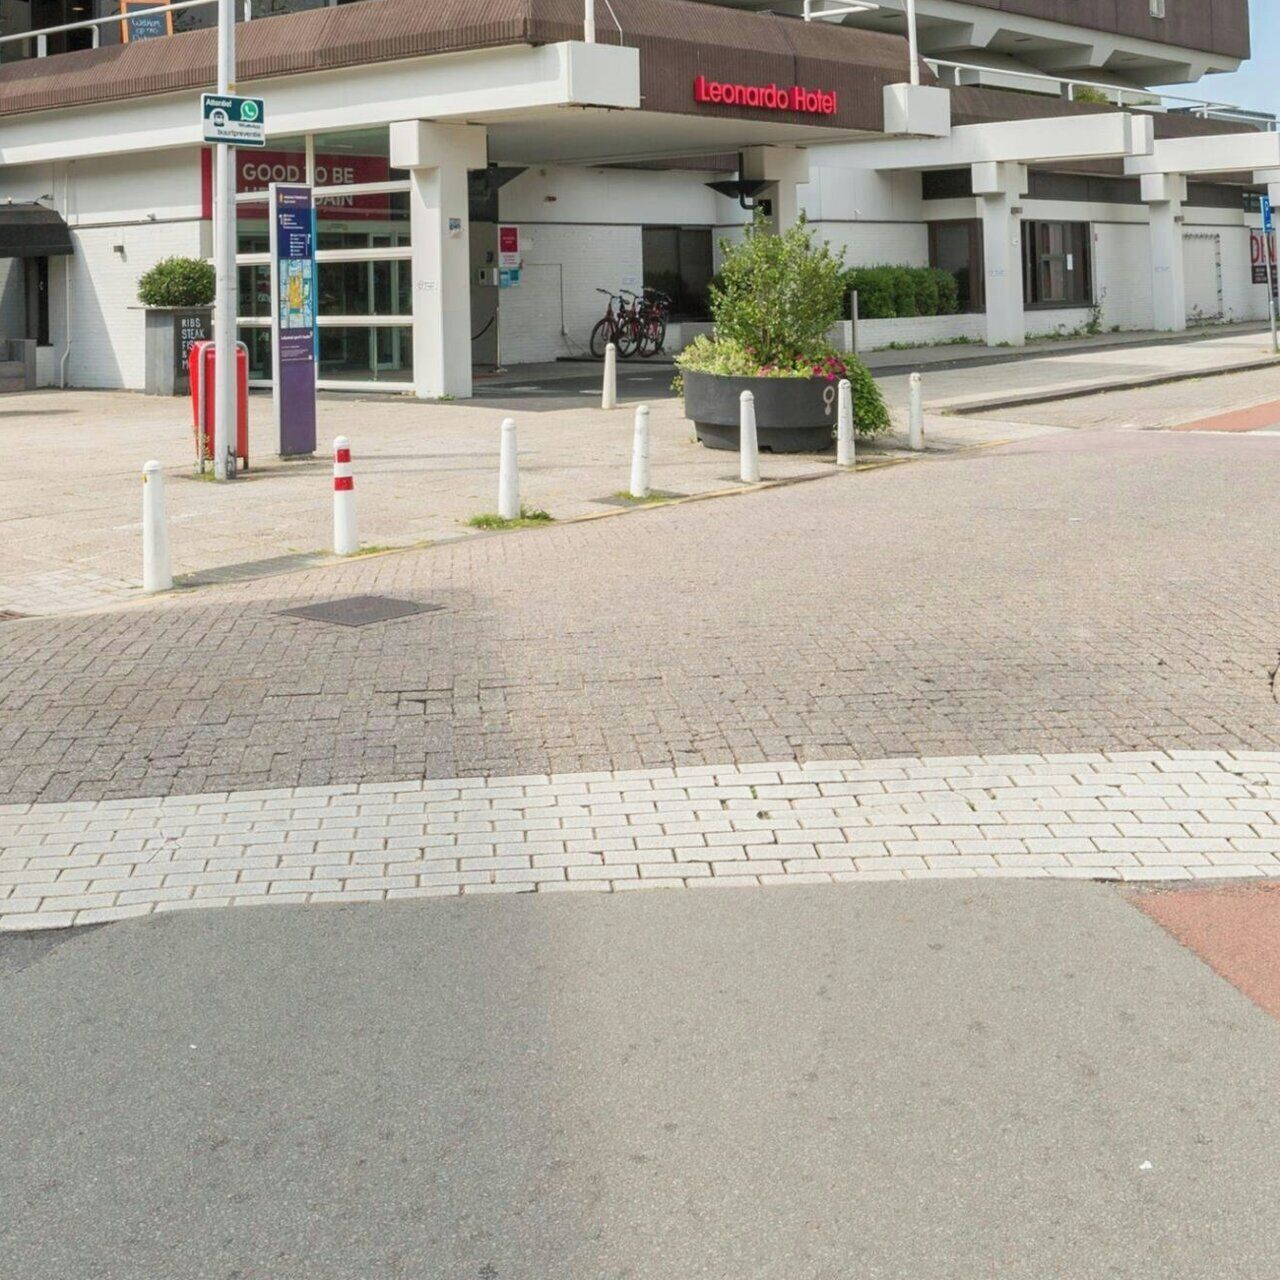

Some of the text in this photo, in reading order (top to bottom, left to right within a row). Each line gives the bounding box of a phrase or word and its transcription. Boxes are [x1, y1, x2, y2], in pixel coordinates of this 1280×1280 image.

[694, 75, 837, 114] Leonardo Hotel
[217, 129, 261, 137] buurtpreventie
[242, 163, 355, 184] GOOD O BE
[181, 318, 201, 328] RIBS
[181, 328, 205, 340] STEAK
